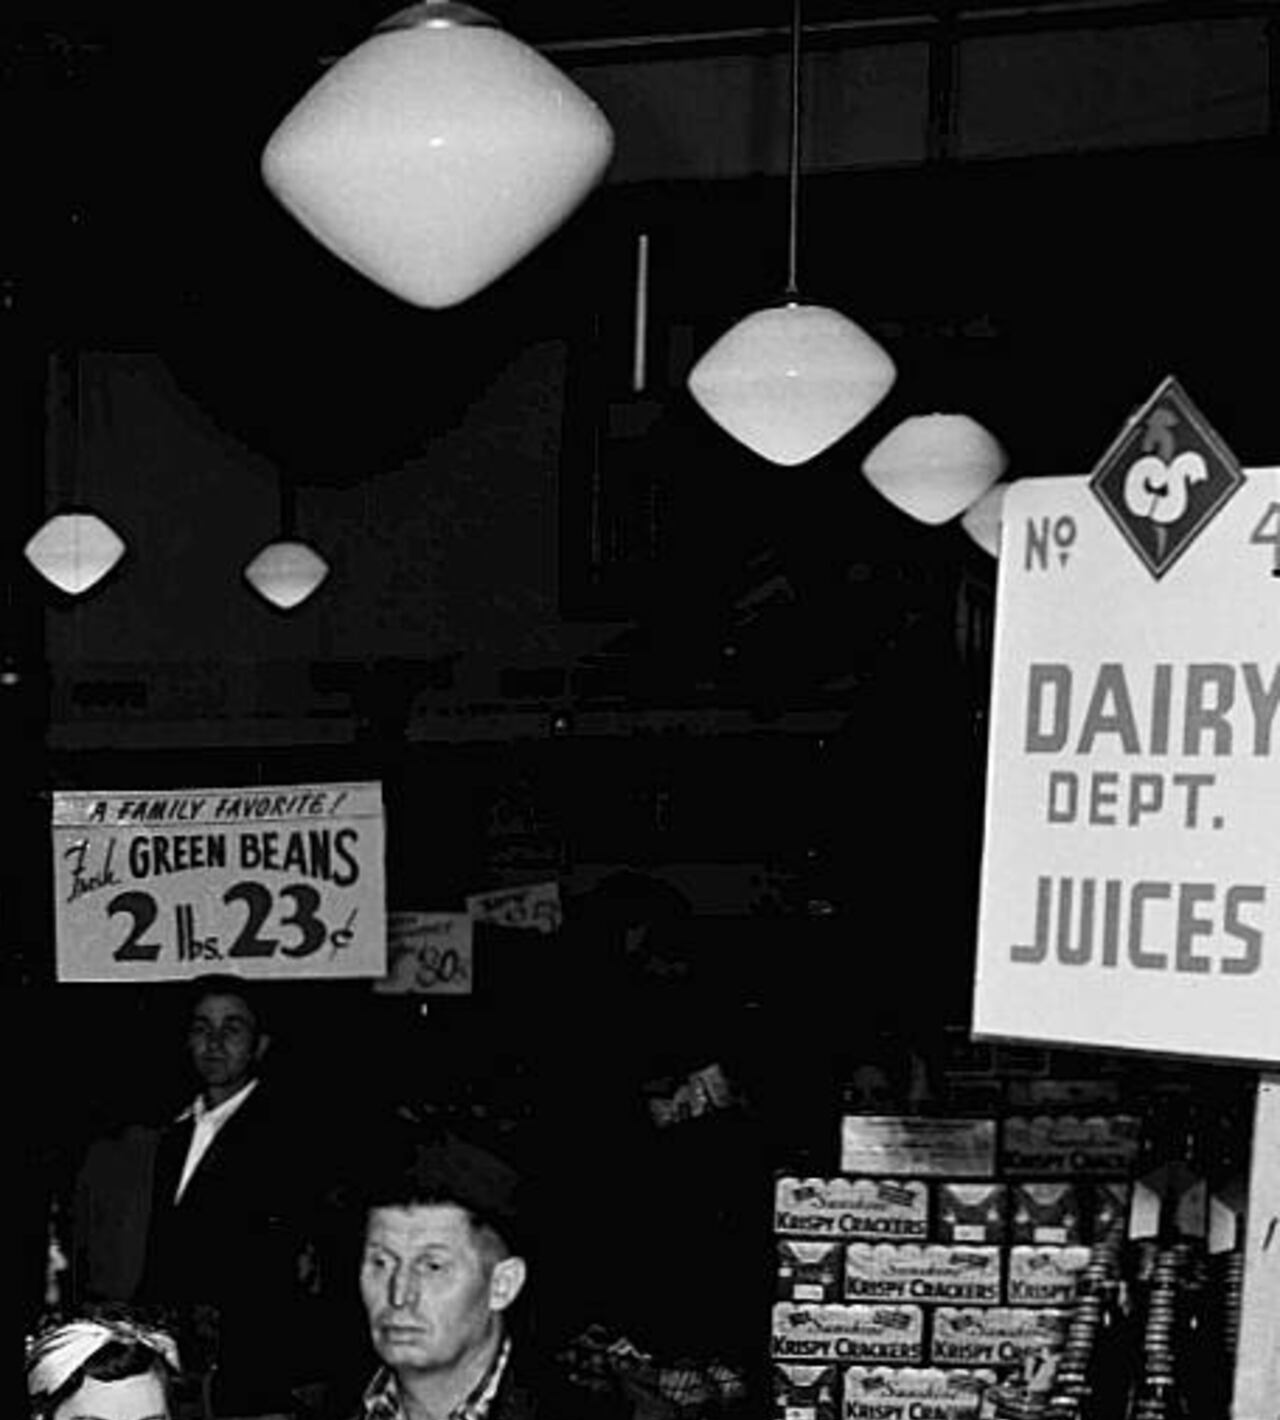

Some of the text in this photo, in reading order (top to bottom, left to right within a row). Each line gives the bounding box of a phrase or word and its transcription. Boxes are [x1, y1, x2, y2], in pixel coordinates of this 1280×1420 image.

[1025, 662, 1280, 756] DAIRY
[90, 801, 107, 823] A
[118, 799, 205, 821] FAMILY
[1047, 772, 1224, 830] DEPT.
[129, 833, 226, 879] GREEN
[240, 827, 359, 887] BEANS
[106, 890, 162, 962] 2
[175, 903, 224, 961] lbs.
[1010, 876, 1267, 976] JUICES
[776, 1211, 928, 1236] KRISPY CRACKERS
[845, 1276, 1000, 1300] KRISPY CRACKERS
[773, 1335, 923, 1358] KRISPY CRACKERS
[932, 1340, 992, 1360] KRISPY
[845, 1401, 905, 1420] KRISPY
